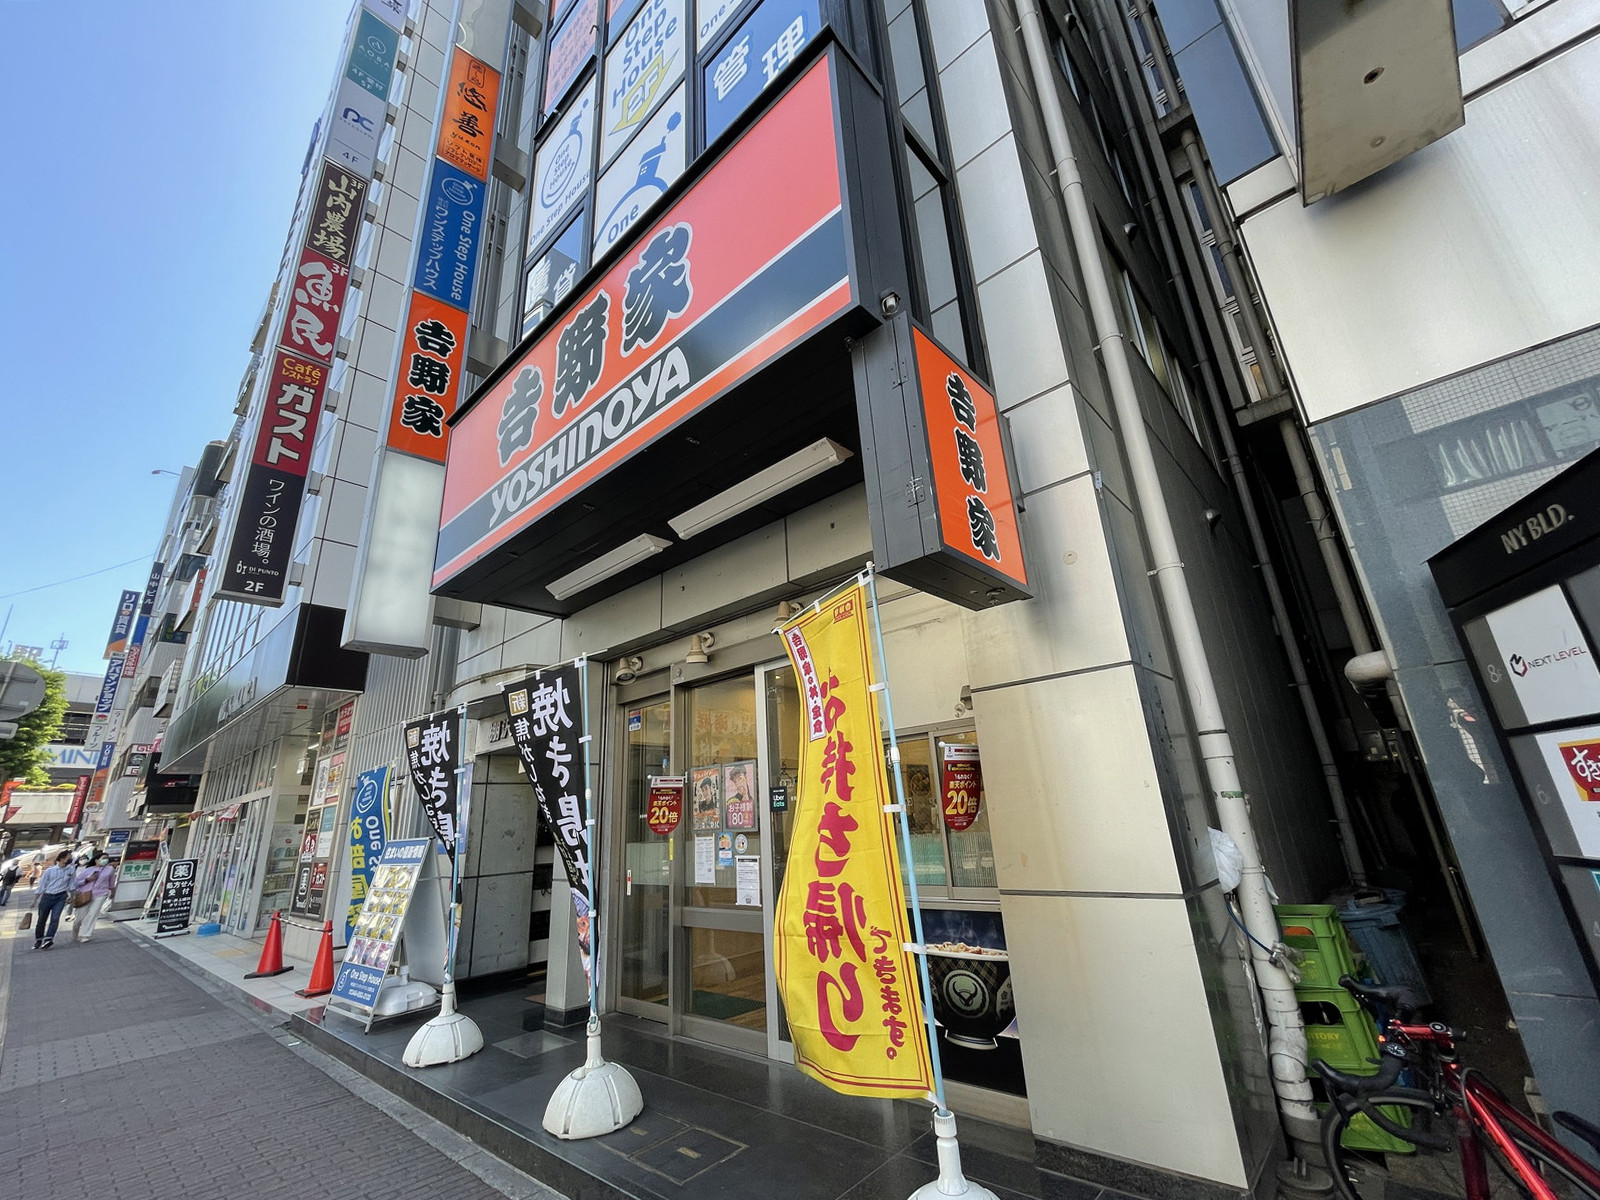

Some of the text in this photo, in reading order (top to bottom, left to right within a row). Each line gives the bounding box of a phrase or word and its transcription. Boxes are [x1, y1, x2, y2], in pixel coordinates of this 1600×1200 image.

[700, 4, 727, 38] One
[713, 15, 806, 101] 管理
[343, 152, 359, 163] 4F
[350, 179, 363, 190] 3F
[314, 174, 357, 260] 山内農場
[607, 203, 640, 245] One
[331, 263, 348, 276] 3F
[450, 210, 475, 301] One Step House
[282, 367, 319, 386] レストラン
[283, 357, 321, 379] Café
[266, 383, 316, 465] ガスト
[488, 346, 691, 528] YOSHINOYA
[251, 478, 286, 564] ワインの酒場。
[1501, 503, 1575, 554] NY BLD.
[244, 580, 265, 592] 2F
[1527, 655, 1552, 669] NEXT
[1553, 647, 1587, 662] LEVEL
[649, 806, 679, 824] 20倍
